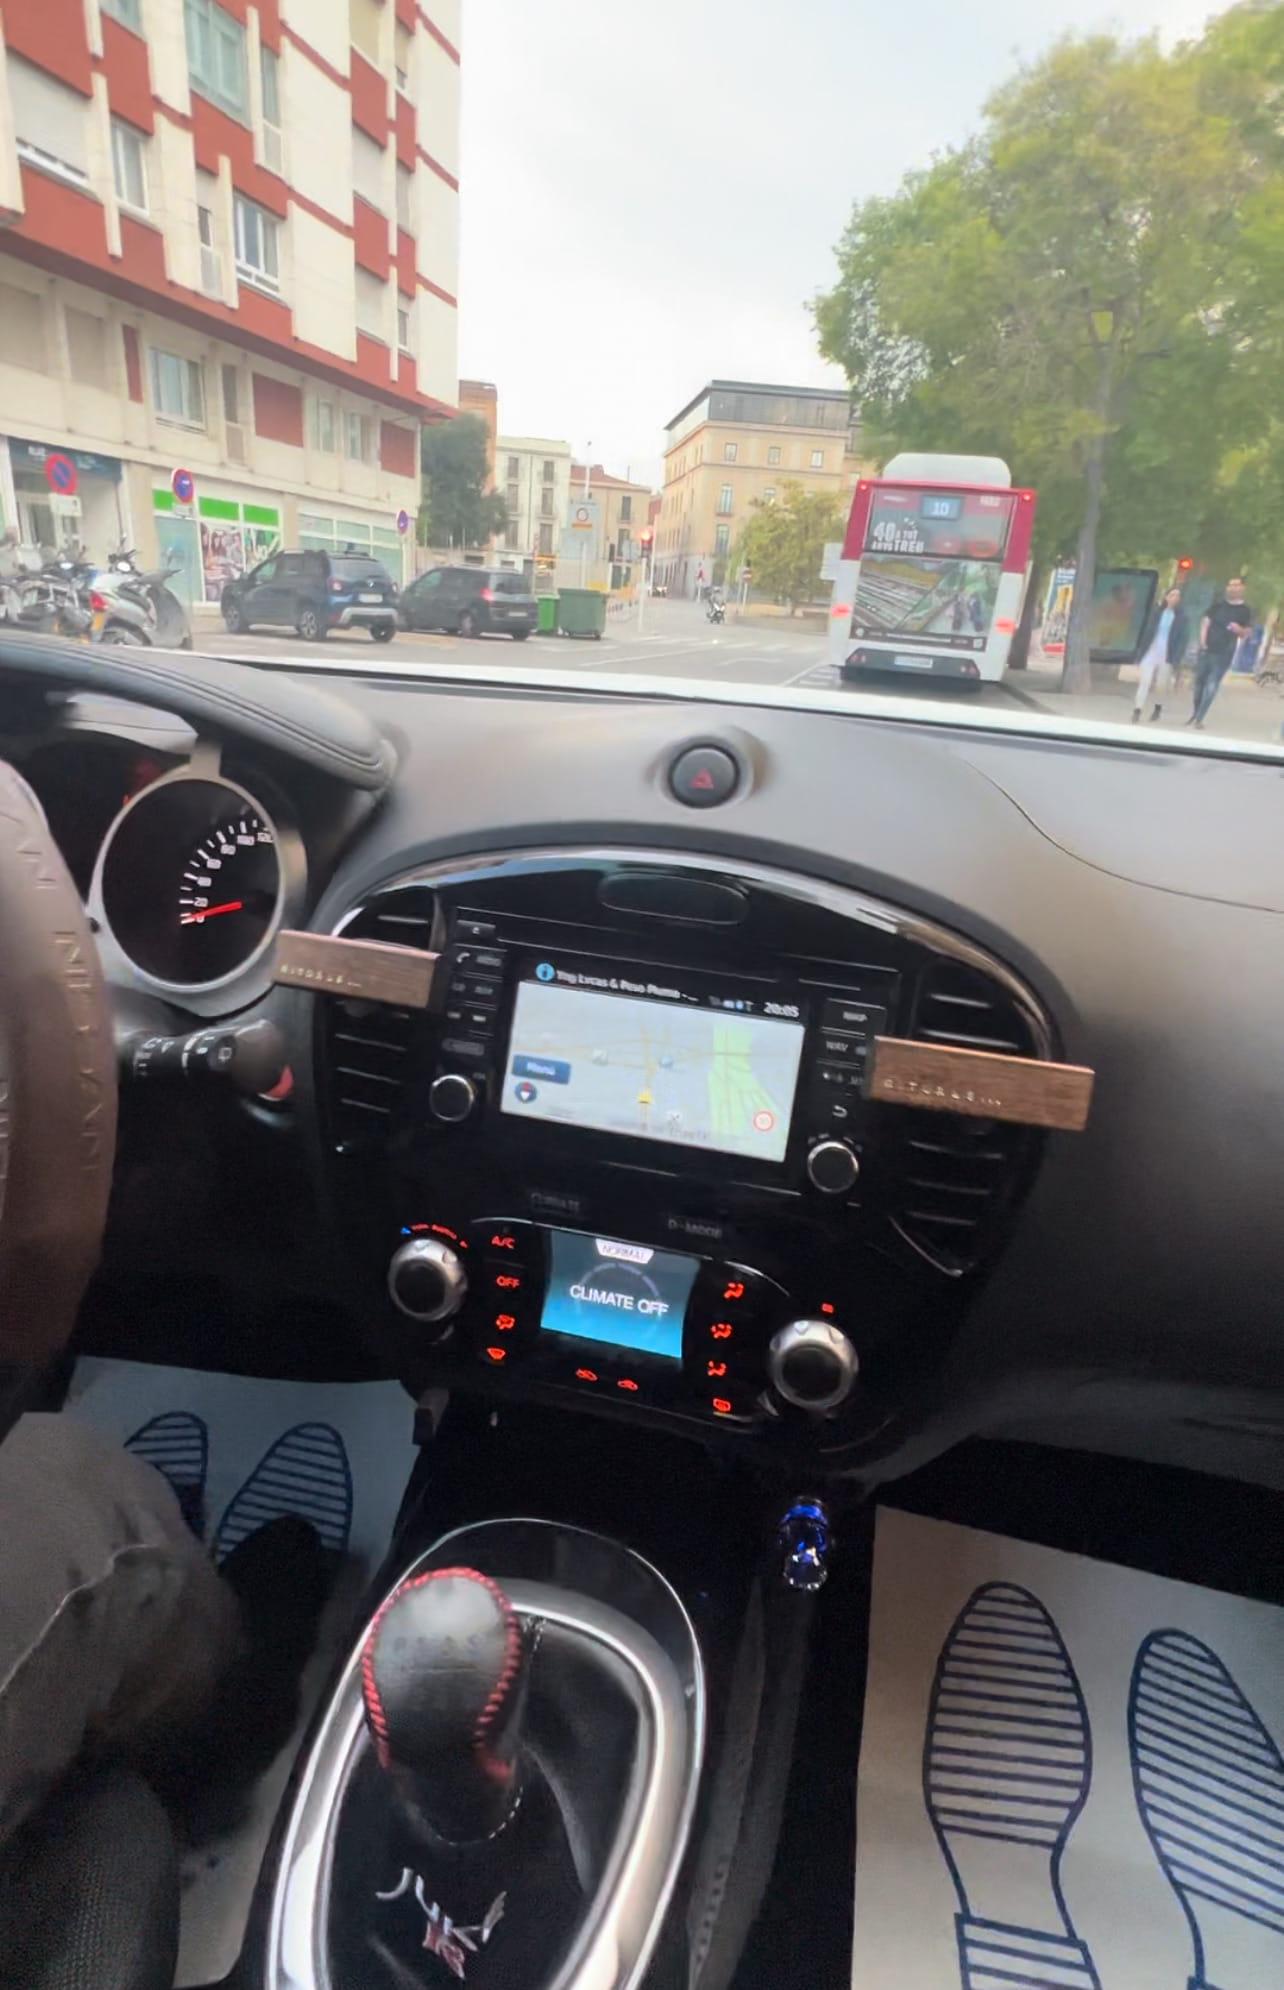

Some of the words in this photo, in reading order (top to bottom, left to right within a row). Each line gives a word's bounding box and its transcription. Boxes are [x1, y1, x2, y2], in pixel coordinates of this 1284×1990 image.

[932, 501, 949, 516] 10
[873, 521, 896, 543] 40
[764, 1001, 799, 1018] 20:05
[496, 1275, 520, 1288] OFF
[570, 1284, 634, 1310] CLIMATE
[637, 1298, 670, 1315] OFF
